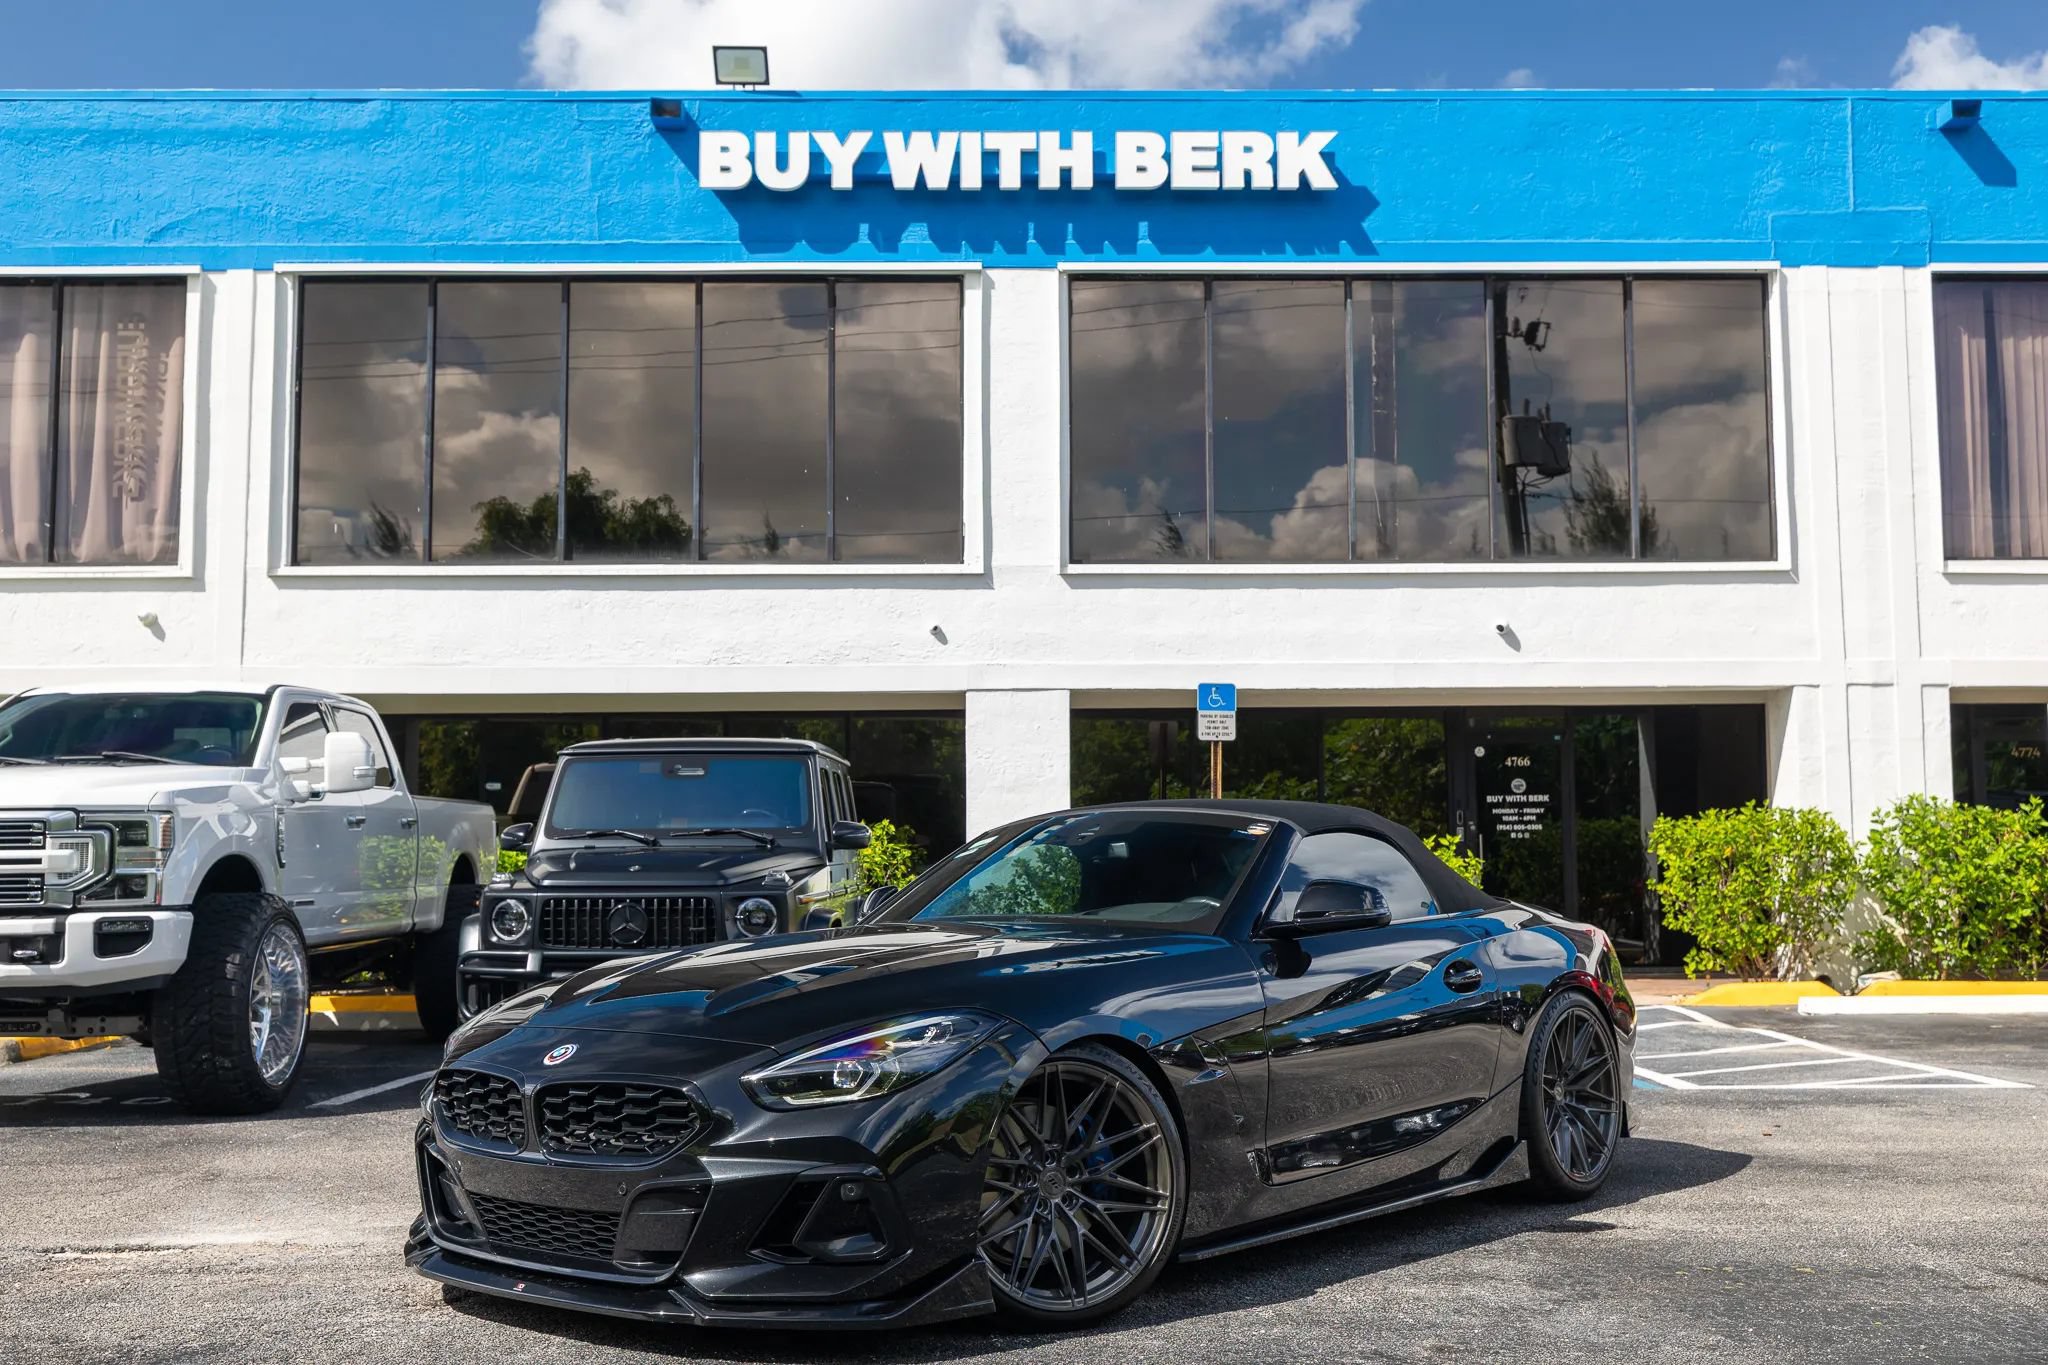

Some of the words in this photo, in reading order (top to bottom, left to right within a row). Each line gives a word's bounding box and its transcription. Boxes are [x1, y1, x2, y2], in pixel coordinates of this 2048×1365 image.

[699, 130, 873, 191] BUY
[883, 130, 1093, 191] WITH
[1114, 130, 1339, 191] BERK
[2011, 746, 2041, 758] 4774
[1505, 756, 1530, 766] 4766
[1486, 795, 1503, 803] BUY
[1505, 795, 1527, 803] WITH
[1528, 794, 1550, 802] BERK
[1532, 991, 1574, 1086] CONTINENTAL
